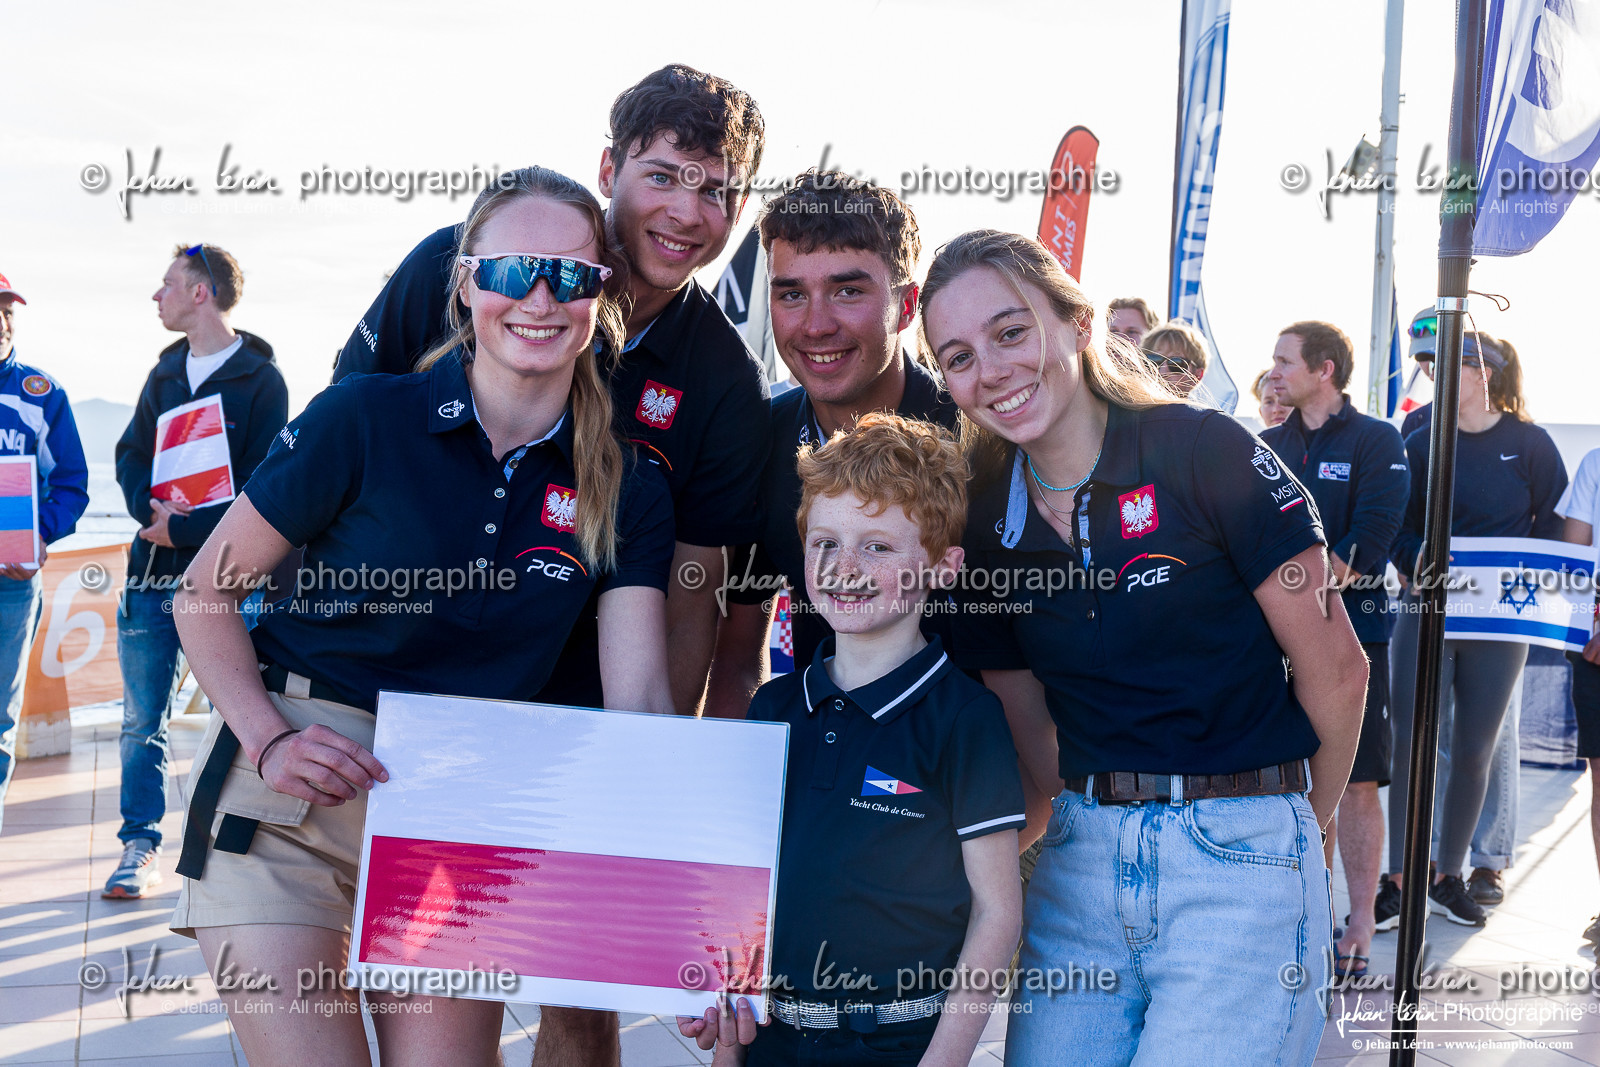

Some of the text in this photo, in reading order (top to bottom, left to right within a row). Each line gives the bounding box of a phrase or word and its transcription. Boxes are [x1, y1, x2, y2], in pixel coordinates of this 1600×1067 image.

[526, 557, 575, 582] PGE
[1127, 565, 1171, 592] PGE
[850, 797, 926, 819] Yacht Club de Cannes
